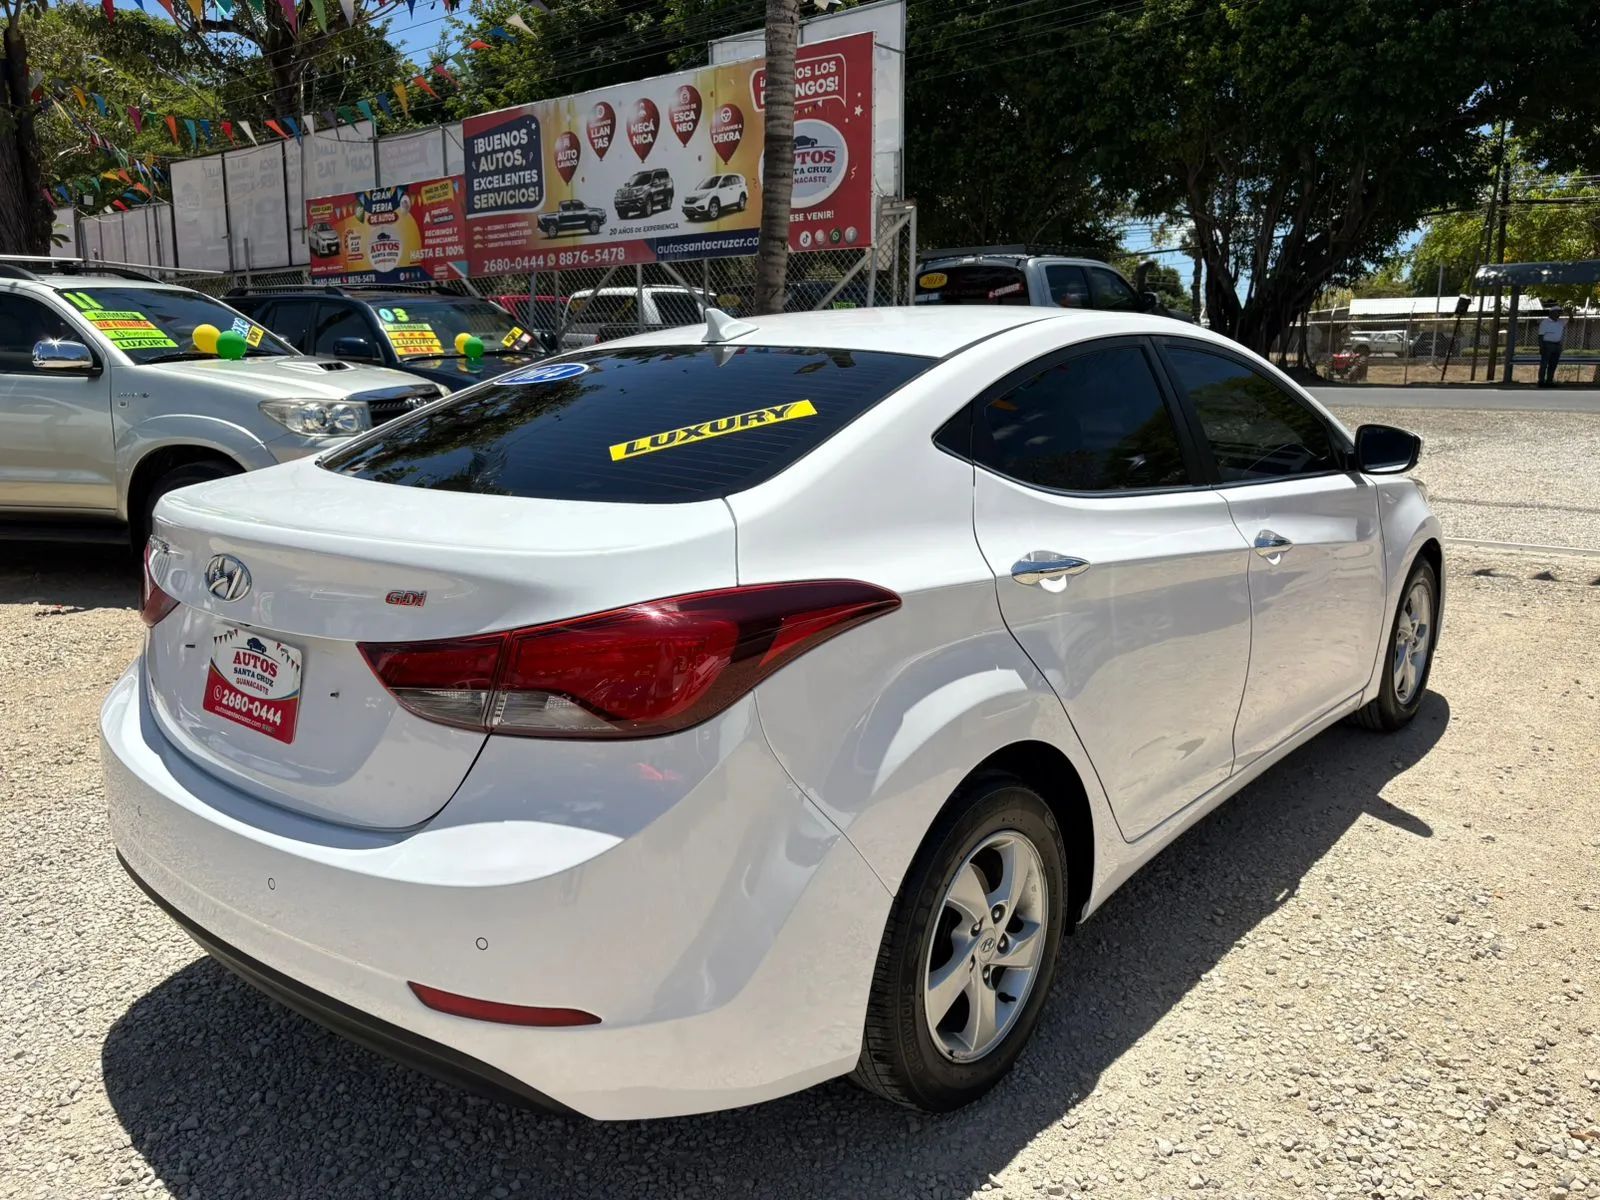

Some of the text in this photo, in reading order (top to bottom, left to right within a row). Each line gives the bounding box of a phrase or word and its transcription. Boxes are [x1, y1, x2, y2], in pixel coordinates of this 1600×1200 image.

[815, 60, 836, 76] LOS
[795, 75, 839, 98] NGOS!
[673, 110, 696, 123] ESCA
[590, 125, 611, 138] LLAN
[631, 117, 655, 133] MECÁ
[676, 122, 694, 133] NEO
[474, 128, 529, 154] ¡BUENOS
[593, 137, 609, 149] TAS
[632, 133, 653, 145] NICA
[712, 130, 741, 144] DEKRA
[479, 149, 526, 173] AUTOS,
[558, 149, 578, 161] AUTO
[807, 166, 833, 174] CRUZ
[473, 169, 539, 191] EXCELENTES
[794, 176, 827, 185] NACASTE
[372, 192, 392, 201] GRAN
[473, 186, 540, 209] SERVICIOS!
[372, 202, 393, 213] FERIA
[370, 213, 396, 223] DE AUTOS
[424, 212, 431, 223] A
[806, 210, 834, 221] VENIR!
[609, 221, 680, 236] 20 AÑOS DE EXPERIENCIA
[371, 242, 400, 254] AUTOS
[410, 245, 464, 259] HASTA EL 100%
[657, 236, 760, 255] autossantacruzcr.co
[483, 247, 625, 273] 2680-0444 8876-5478
[63, 292, 104, 309] 11
[96, 320, 110, 328] WE
[120, 339, 169, 348] LUXURY
[403, 346, 435, 354] SALE
[623, 403, 798, 456] LUXURY
[233, 650, 278, 678] AUTOS
[233, 666, 274, 688] SANTA CRUZ
[236, 676, 269, 695] GUANACASTE
[222, 689, 282, 726] 2680-0444
